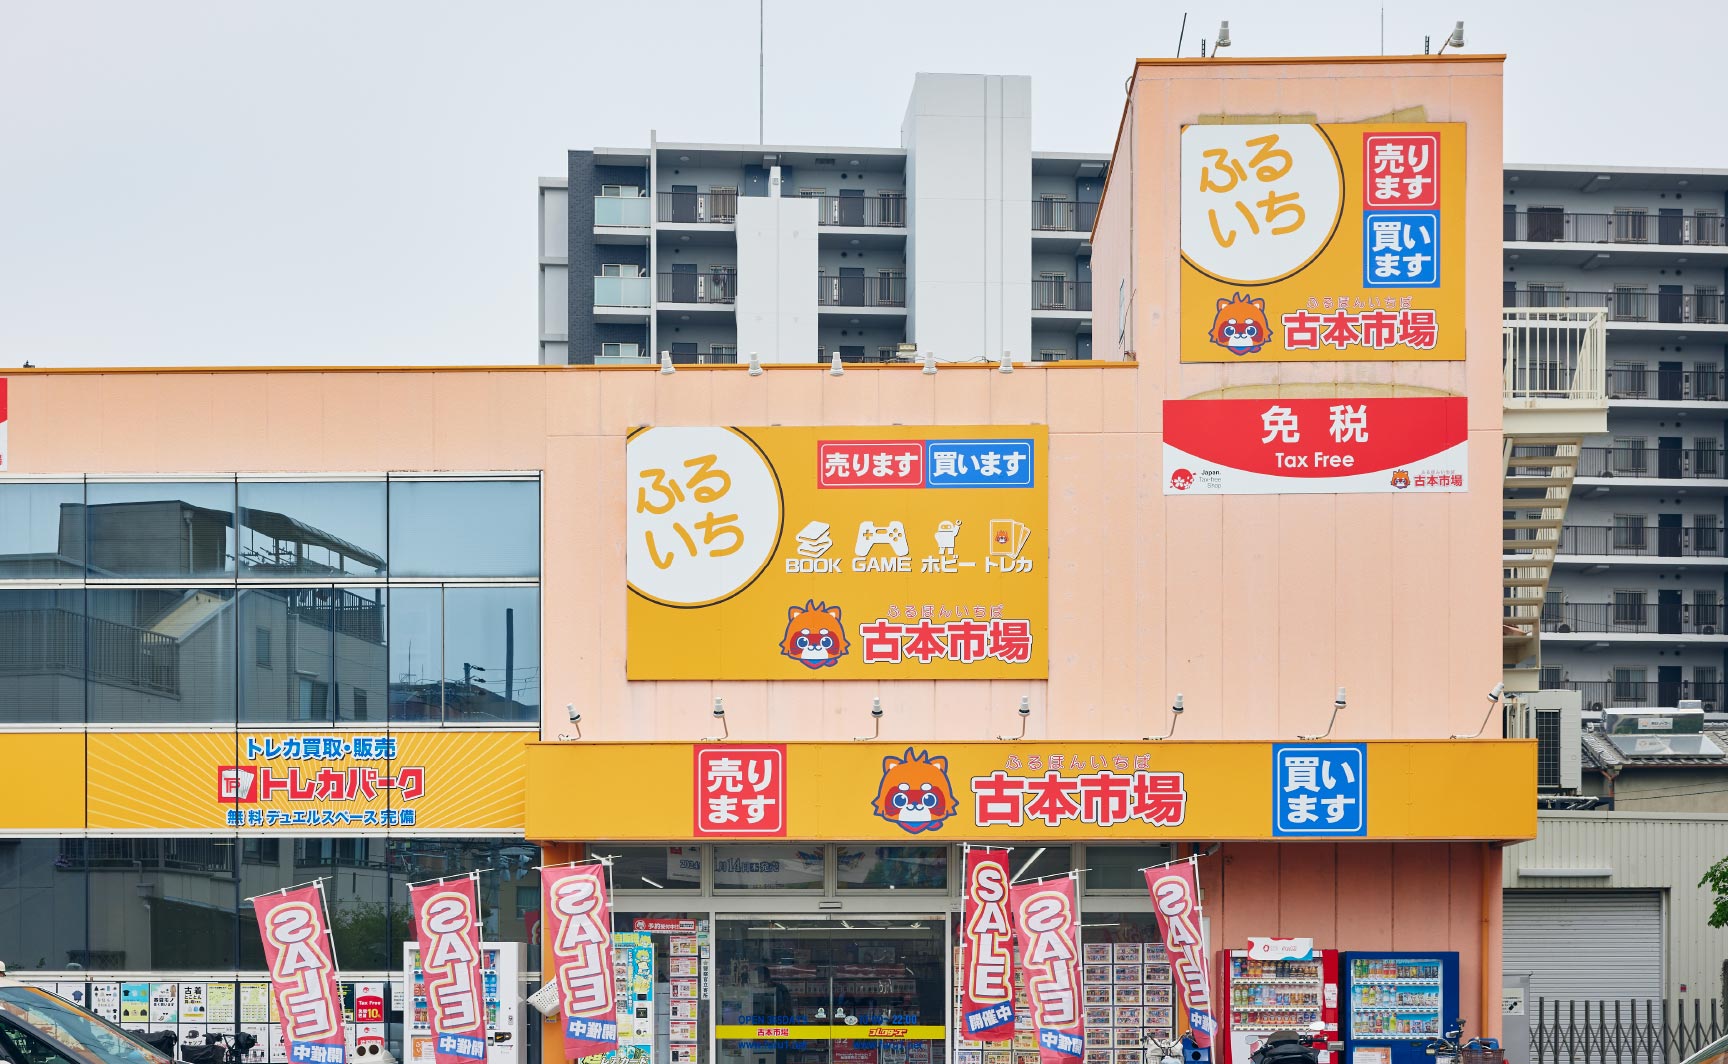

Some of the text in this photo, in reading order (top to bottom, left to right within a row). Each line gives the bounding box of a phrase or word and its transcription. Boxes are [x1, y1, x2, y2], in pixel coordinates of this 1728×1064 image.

[1200, 134, 1294, 193] ふる
[1374, 143, 1430, 173] 売り
[1374, 176, 1432, 199] ます
[1208, 191, 1306, 249] いち
[1372, 222, 1431, 251] 買い
[1374, 253, 1431, 278] ます
[1282, 309, 1439, 350] 古本市場
[825, 451, 919, 478] 売ります
[933, 451, 1027, 477] 買います
[1275, 451, 1355, 468] Tax Free
[637, 454, 731, 515] ふる
[1414, 474, 1463, 487] 古本市場
[645, 512, 744, 570] いち
[785, 558, 843, 573] BOOK
[852, 557, 912, 573] GAME
[921, 556, 976, 573] ホビー
[984, 557, 1033, 573] トレカ
[860, 619, 1034, 664] 古本市場
[247, 737, 397, 759] トレカ買取・販売
[1005, 754, 1151, 770] ふるほんいちば
[260, 766, 425, 802] トレカパーク
[706, 758, 774, 793] 売り
[1284, 757, 1355, 793] 買い
[708, 795, 776, 824] ます
[971, 770, 1187, 827] 古本市場
[1286, 794, 1356, 824] ます
[974, 868, 1007, 997] SALE
[738, 1015, 765, 1025] OPEN
[968, 1005, 1013, 1031] 開催中
[757, 1028, 789, 1037] 古本市場
